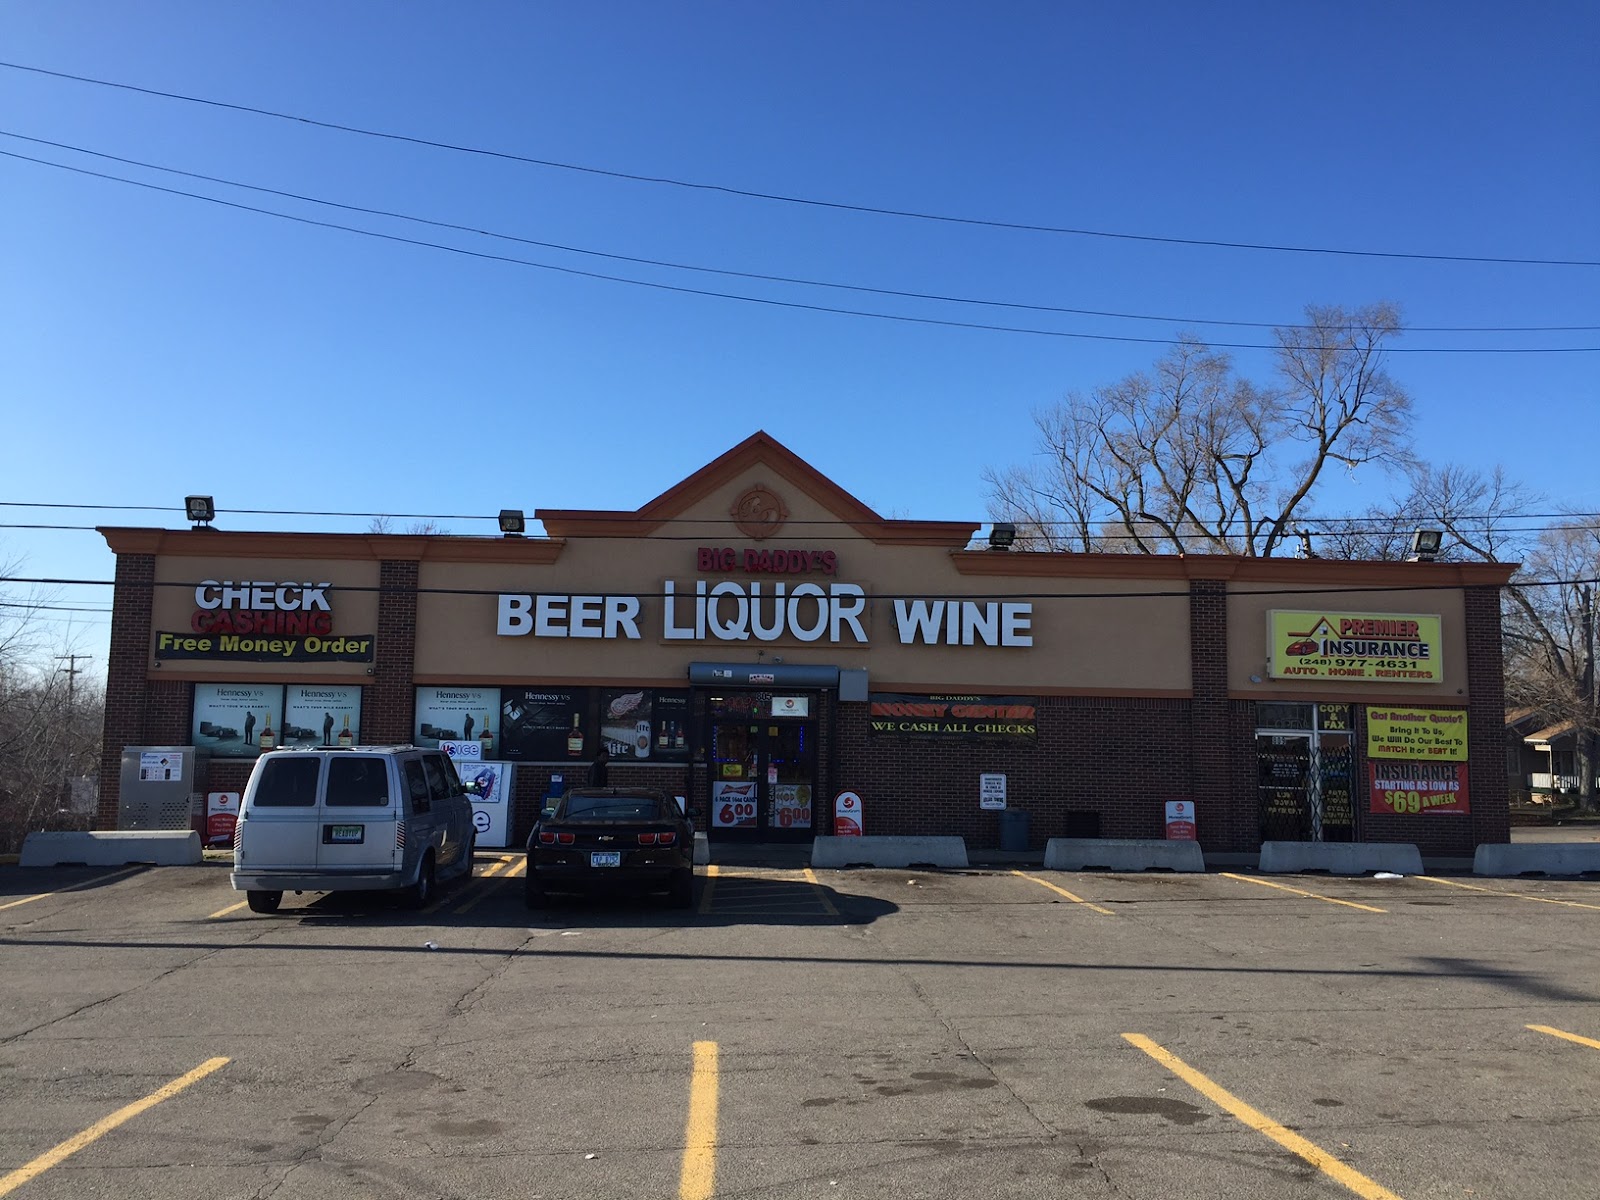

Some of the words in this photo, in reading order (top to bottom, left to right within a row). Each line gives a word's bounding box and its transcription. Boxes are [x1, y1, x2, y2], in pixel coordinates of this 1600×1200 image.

[697, 547, 736, 572] BIG
[743, 549, 837, 575] DADDY'S
[194, 579, 331, 611] CHECK
[496, 594, 641, 639] BEER
[663, 580, 868, 642] LIQUOR
[190, 610, 333, 635] CASHING
[893, 599, 1033, 647] WINE
[1340, 618, 1419, 637] PREMIER
[159, 634, 212, 651] Free
[219, 635, 297, 657] Money
[304, 636, 370, 654] Order
[1299, 658, 1332, 666] (248)
[1335, 659, 1417, 669] 977-4631
[1283, 667, 1318, 676] AUTO
[1328, 668, 1365, 677] HOME
[1375, 669, 1433, 679] RENTERS
[216, 688, 252, 697] Hennessy
[300, 689, 335, 698] Hennessy
[436, 690, 471, 700] Hennessy
[525, 691, 560, 702] Hennessy
[870, 702, 949, 718] MONEY
[951, 704, 1036, 720] CENTER
[1319, 704, 1350, 713] COPY
[1329, 712, 1338, 721] &
[1370, 711, 1388, 721] Got
[1390, 712, 1427, 722] Another
[1429, 714, 1463, 724] Quote?
[871, 721, 896, 731] WE
[898, 721, 939, 732] CASH
[942, 722, 971, 733] ALL
[973, 723, 1036, 734] CHECKS
[1323, 720, 1345, 729] FAX
[1390, 726, 1412, 736] Bring
[1372, 735, 1385, 743] We
[1404, 736, 1415, 744] Do
[1417, 737, 1432, 745] Our
[1435, 737, 1452, 745] Best
[1454, 738, 1463, 746] To
[607, 742, 629, 757] Lite
[1378, 745, 1407, 753] MATCH
[1428, 747, 1448, 755] BEAT
[1375, 764, 1459, 780] INSURANCE
[1374, 780, 1415, 791] STARTING
[1416, 780, 1428, 791] AS
[1429, 780, 1447, 791] LOW
[1448, 781, 1460, 791] AS
[1384, 790, 1421, 814] $69
[1422, 796, 1430, 808] A
[1429, 792, 1457, 806] WEEK
